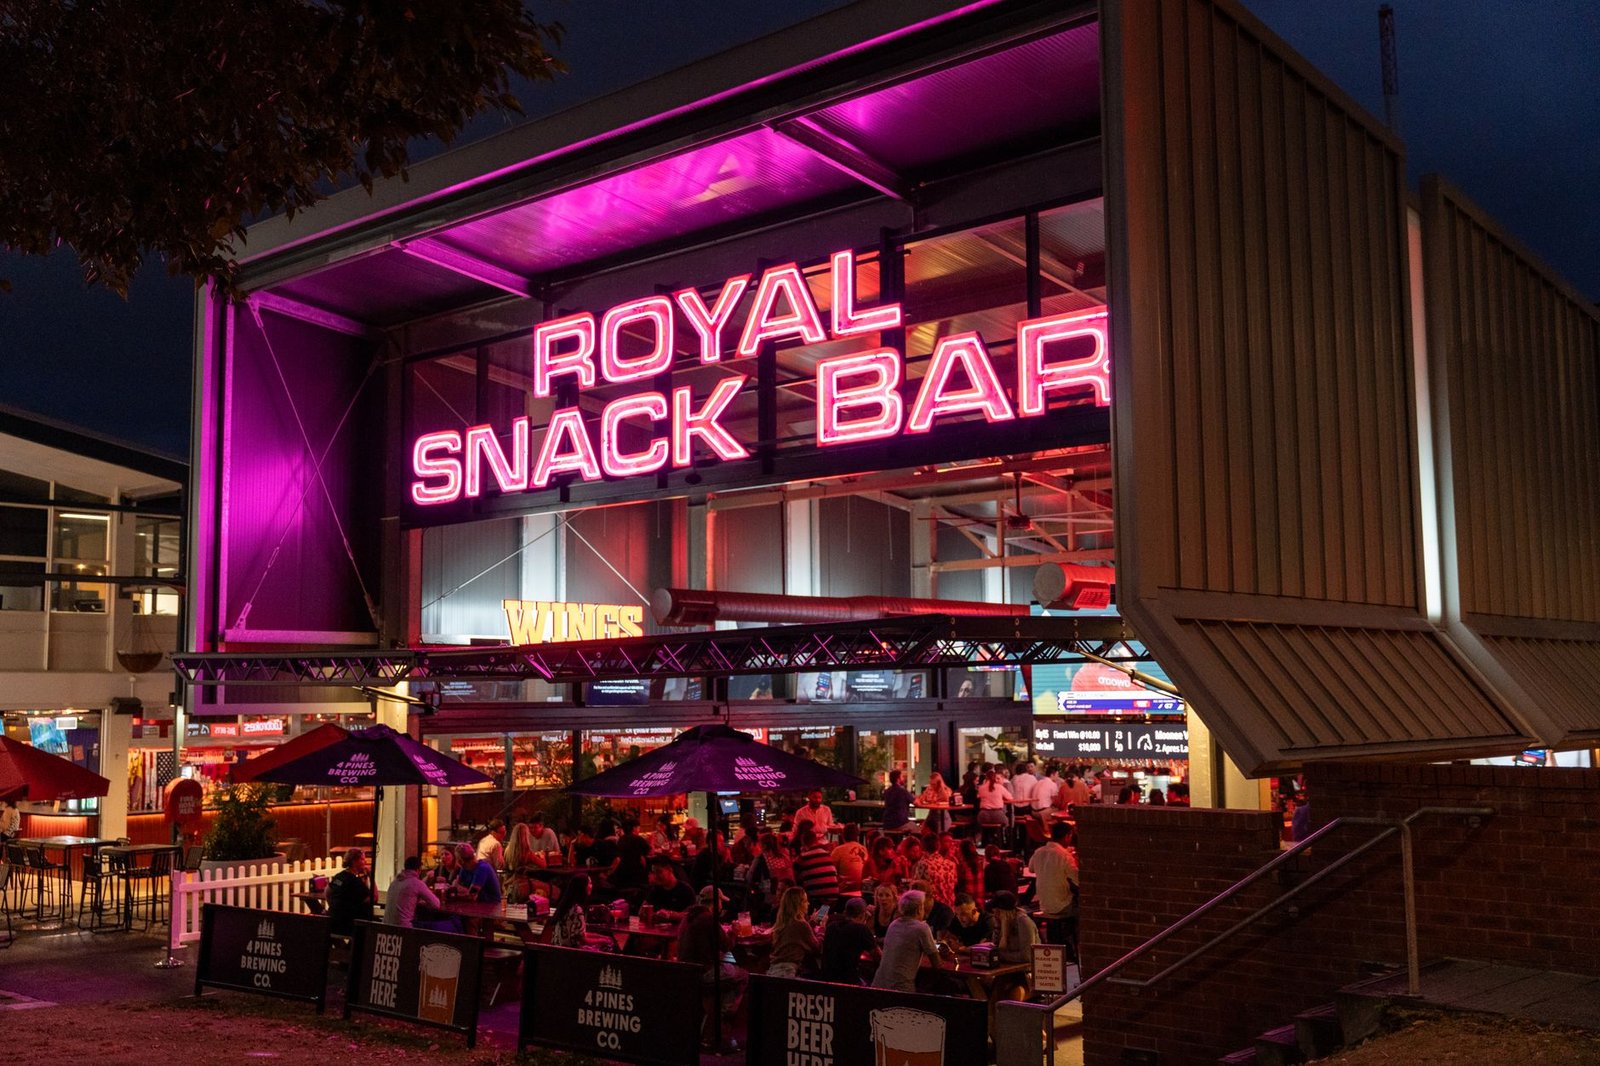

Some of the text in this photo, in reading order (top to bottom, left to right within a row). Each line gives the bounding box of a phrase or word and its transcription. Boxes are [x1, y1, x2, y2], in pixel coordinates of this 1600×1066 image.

[533, 248, 903, 398] ROYAL
[411, 303, 1110, 506] SNACK BAR
[501, 600, 646, 646] WINGS
[328, 768, 377, 776] BREWING
[345, 761, 375, 769] PINES
[743, 765, 774, 774] PINES
[629, 778, 671, 787] BREWING
[649, 771, 674, 779] PINES
[735, 771, 787, 781] BREWING
[758, 780, 780, 788] CO.
[246, 941, 282, 957] 4 PINES
[375, 933, 403, 957] FRESH
[240, 955, 287, 974] BREWING
[372, 956, 400, 982] BEER
[253, 974, 272, 988] CO.
[369, 979, 398, 1008] HERE
[584, 990, 634, 1011] 4 PINES
[788, 992, 835, 1023] FRESH
[577, 1008, 641, 1033] BREWING
[596, 1031, 621, 1050] CO.
[787, 1019, 834, 1055] BEER
